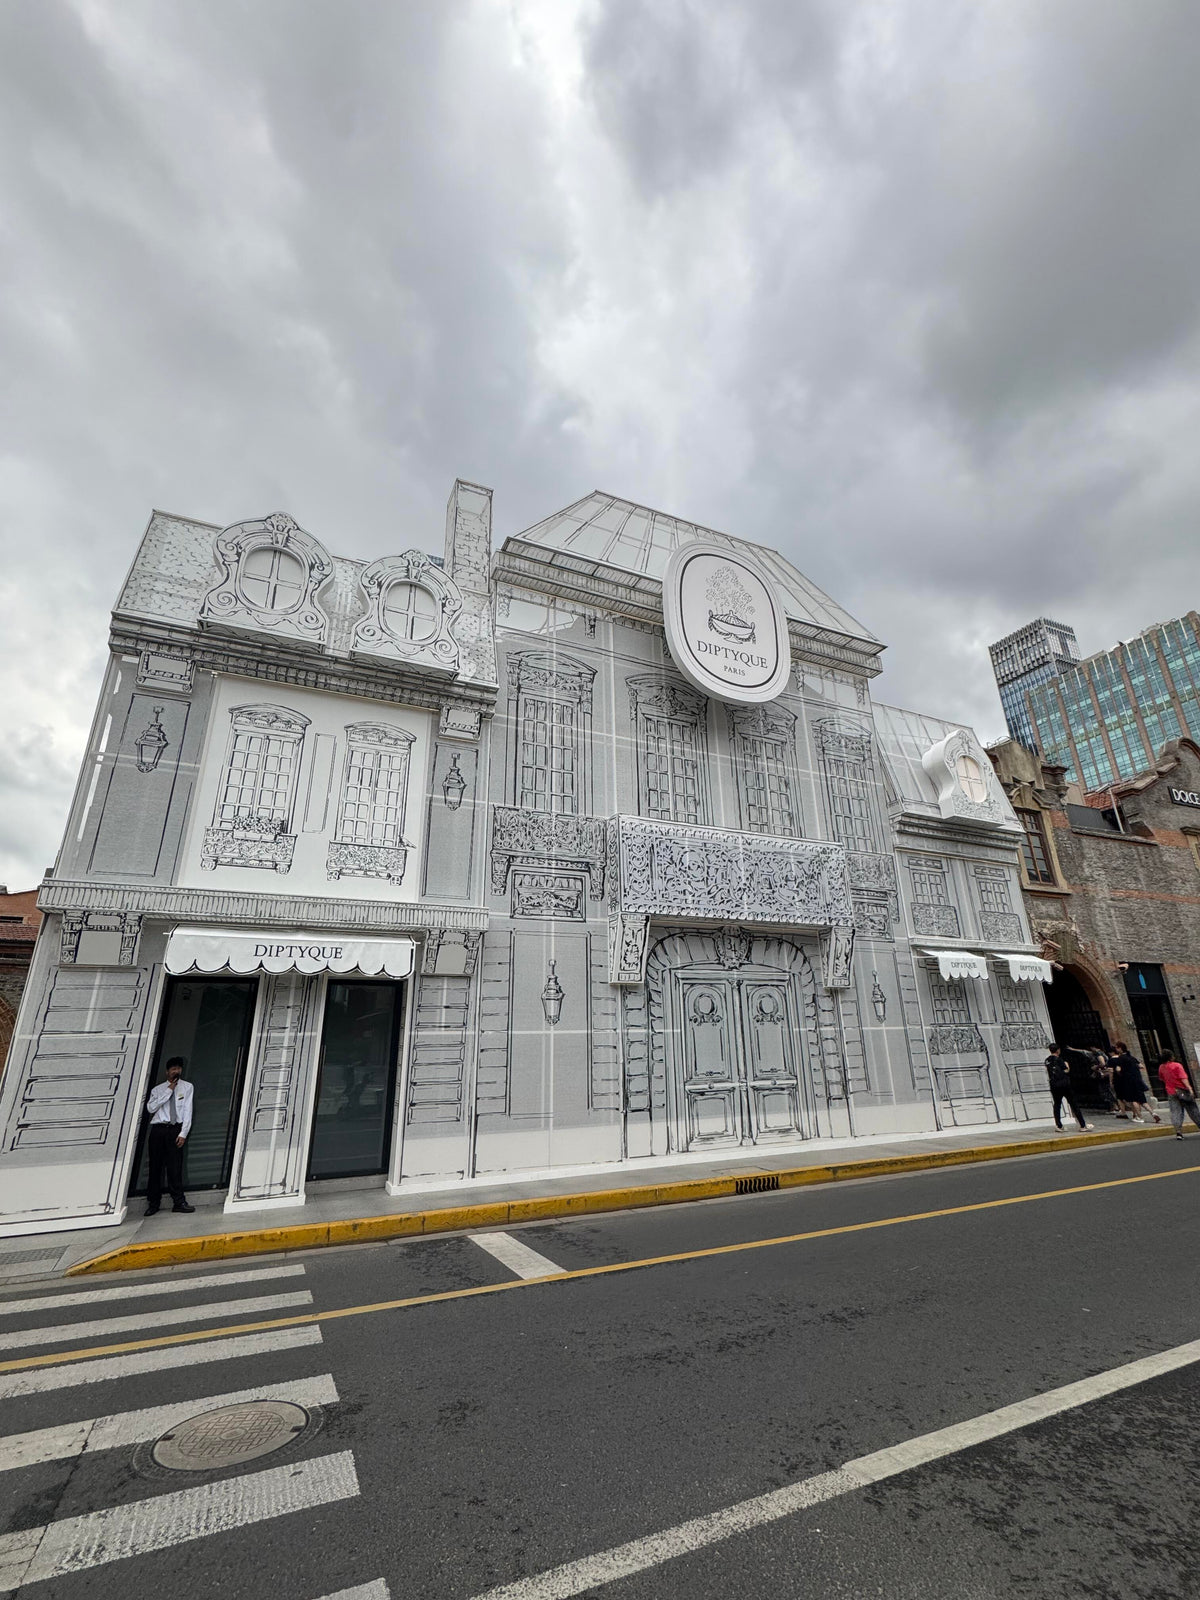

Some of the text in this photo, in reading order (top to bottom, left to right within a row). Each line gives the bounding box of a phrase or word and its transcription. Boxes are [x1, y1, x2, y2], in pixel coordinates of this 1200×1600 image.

[697, 640, 768, 669] DIPTYQUE
[723, 665, 746, 676] PARIS
[1172, 788, 1200, 805] DOLCE
[253, 944, 343, 962] DIPTYQUE
